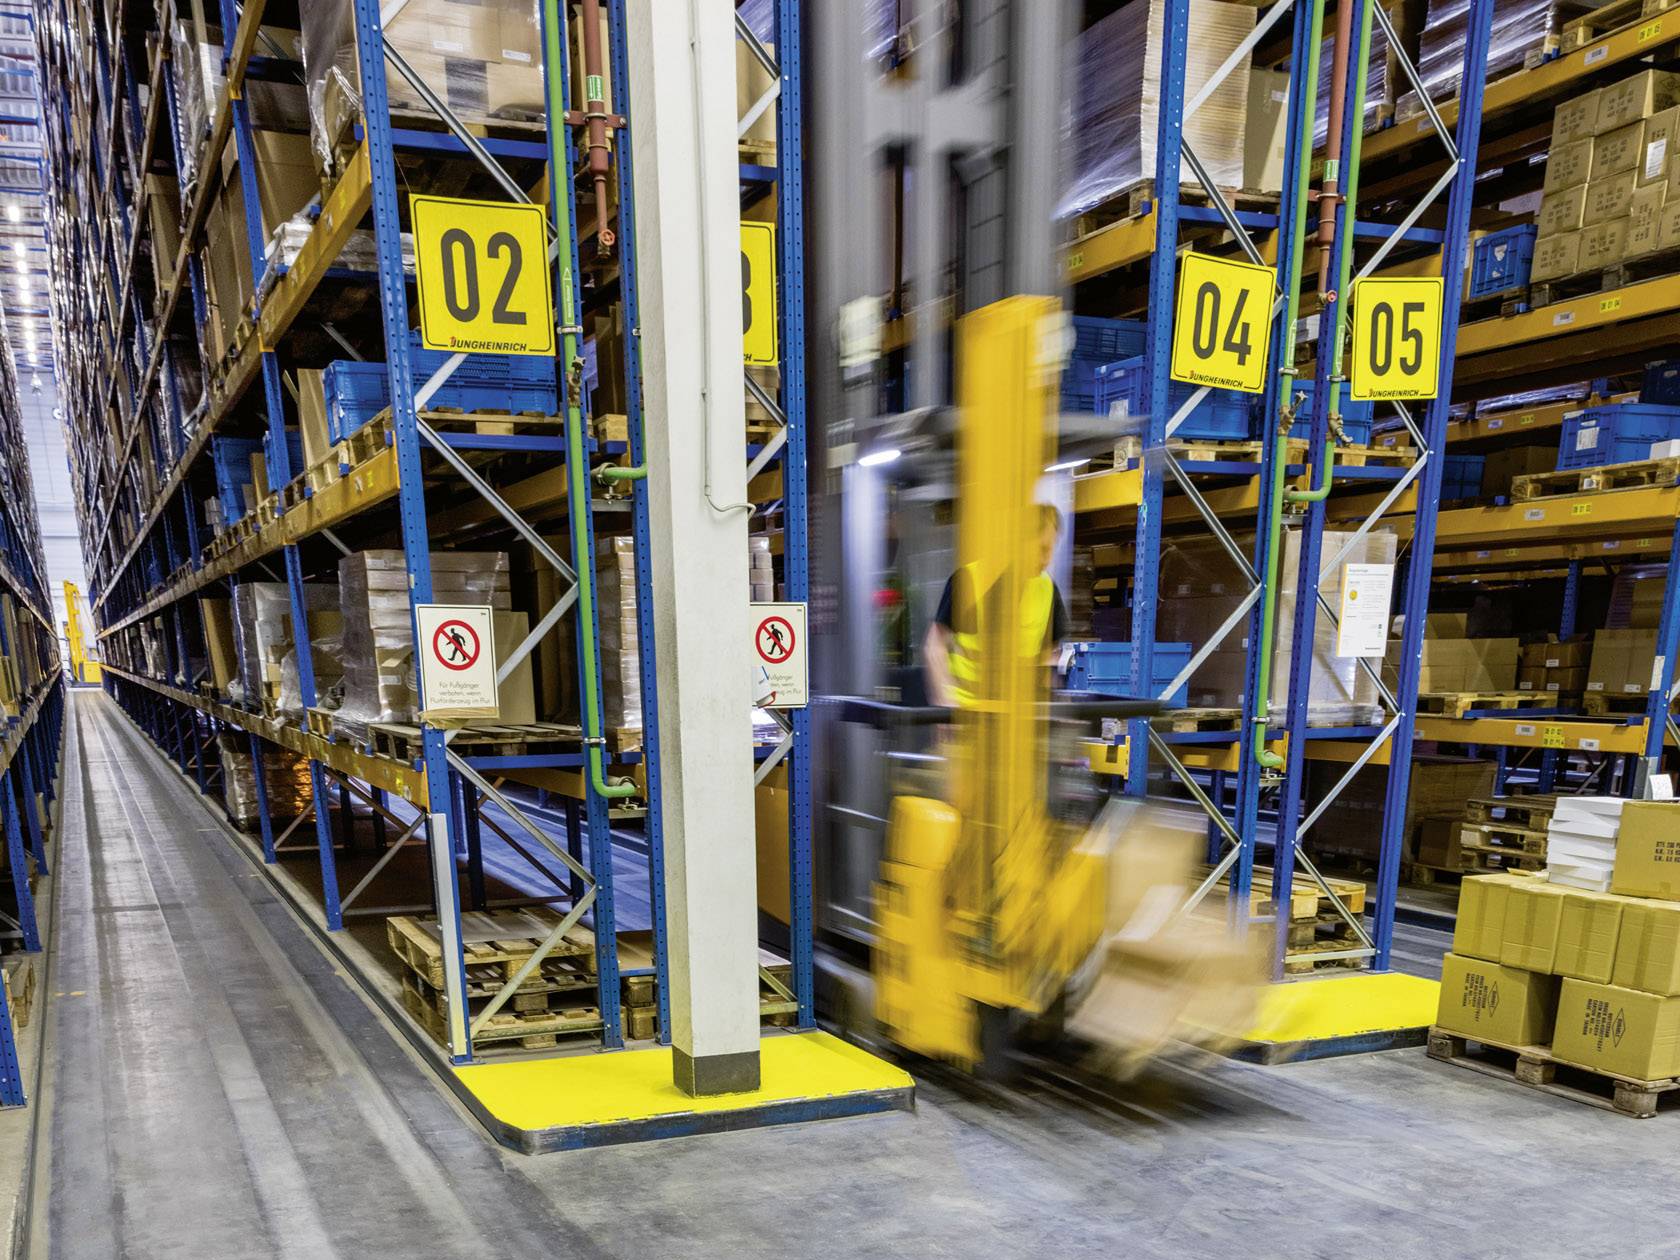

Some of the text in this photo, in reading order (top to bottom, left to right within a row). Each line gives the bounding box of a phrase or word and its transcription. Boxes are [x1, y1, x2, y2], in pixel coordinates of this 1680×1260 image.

[440, 228, 527, 325] 02
[450, 336, 527, 351] JUNGHEINRICH
[1192, 281, 1252, 366] 04
[1369, 302, 1425, 377] 05
[1189, 369, 1243, 387] JUNGHEINRICH
[1368, 388, 1420, 398] JUNGHEINRICH
